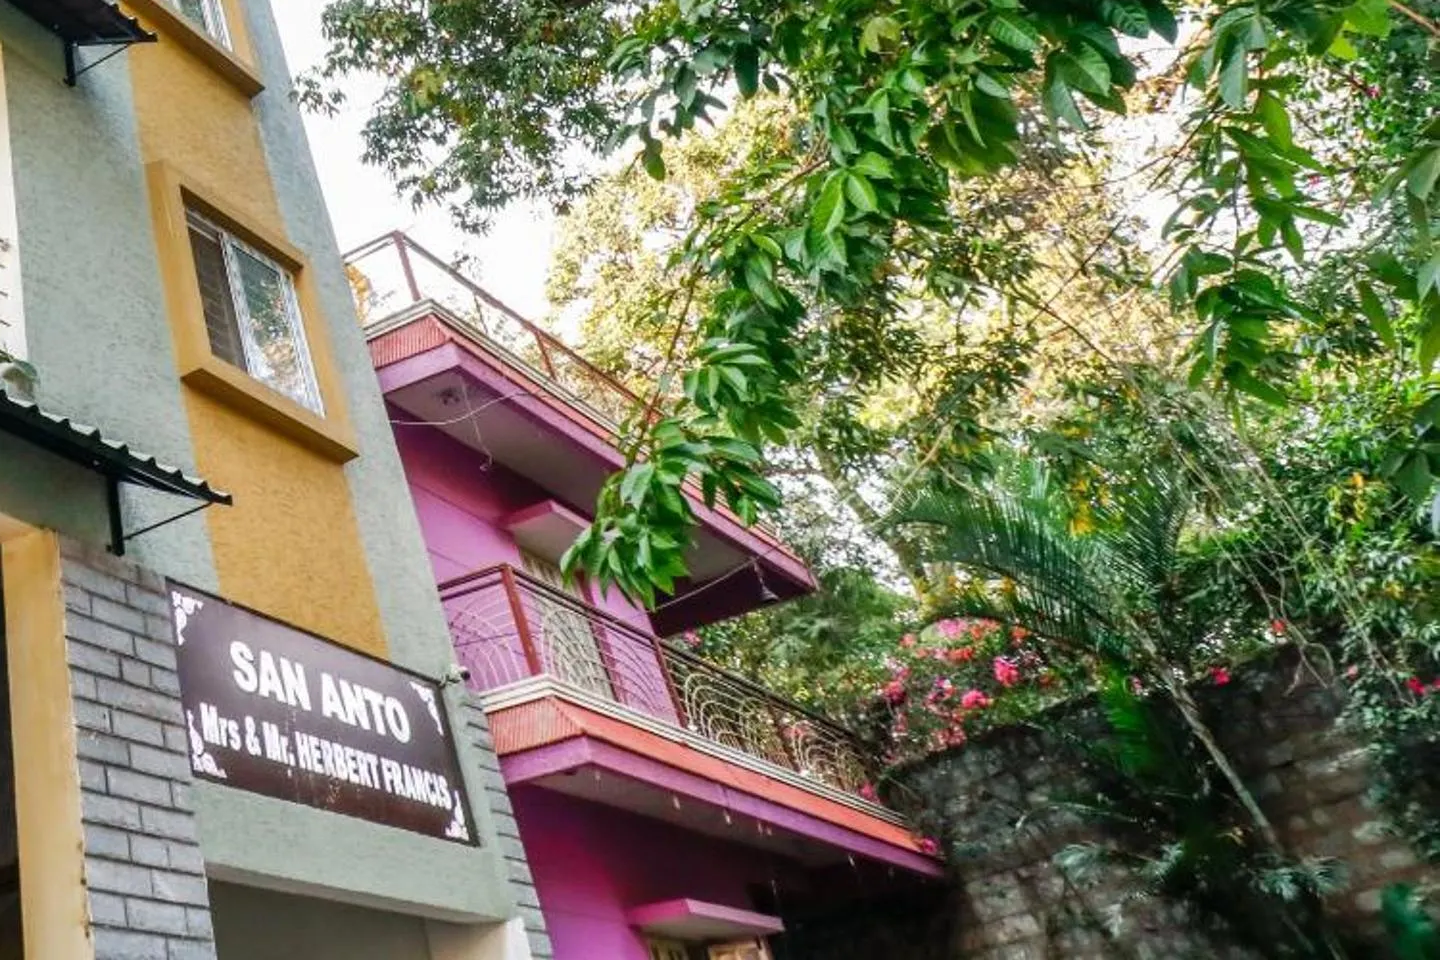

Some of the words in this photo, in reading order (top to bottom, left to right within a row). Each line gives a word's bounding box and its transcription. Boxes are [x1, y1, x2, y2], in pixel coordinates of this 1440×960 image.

[230, 640, 311, 711] SAN
[320, 672, 410, 743] ANTO
[200, 702, 241, 751] Mrs
[245, 715, 261, 756] &
[295, 730, 381, 790] HERBERT
[381, 755, 452, 811] FRANCIS
